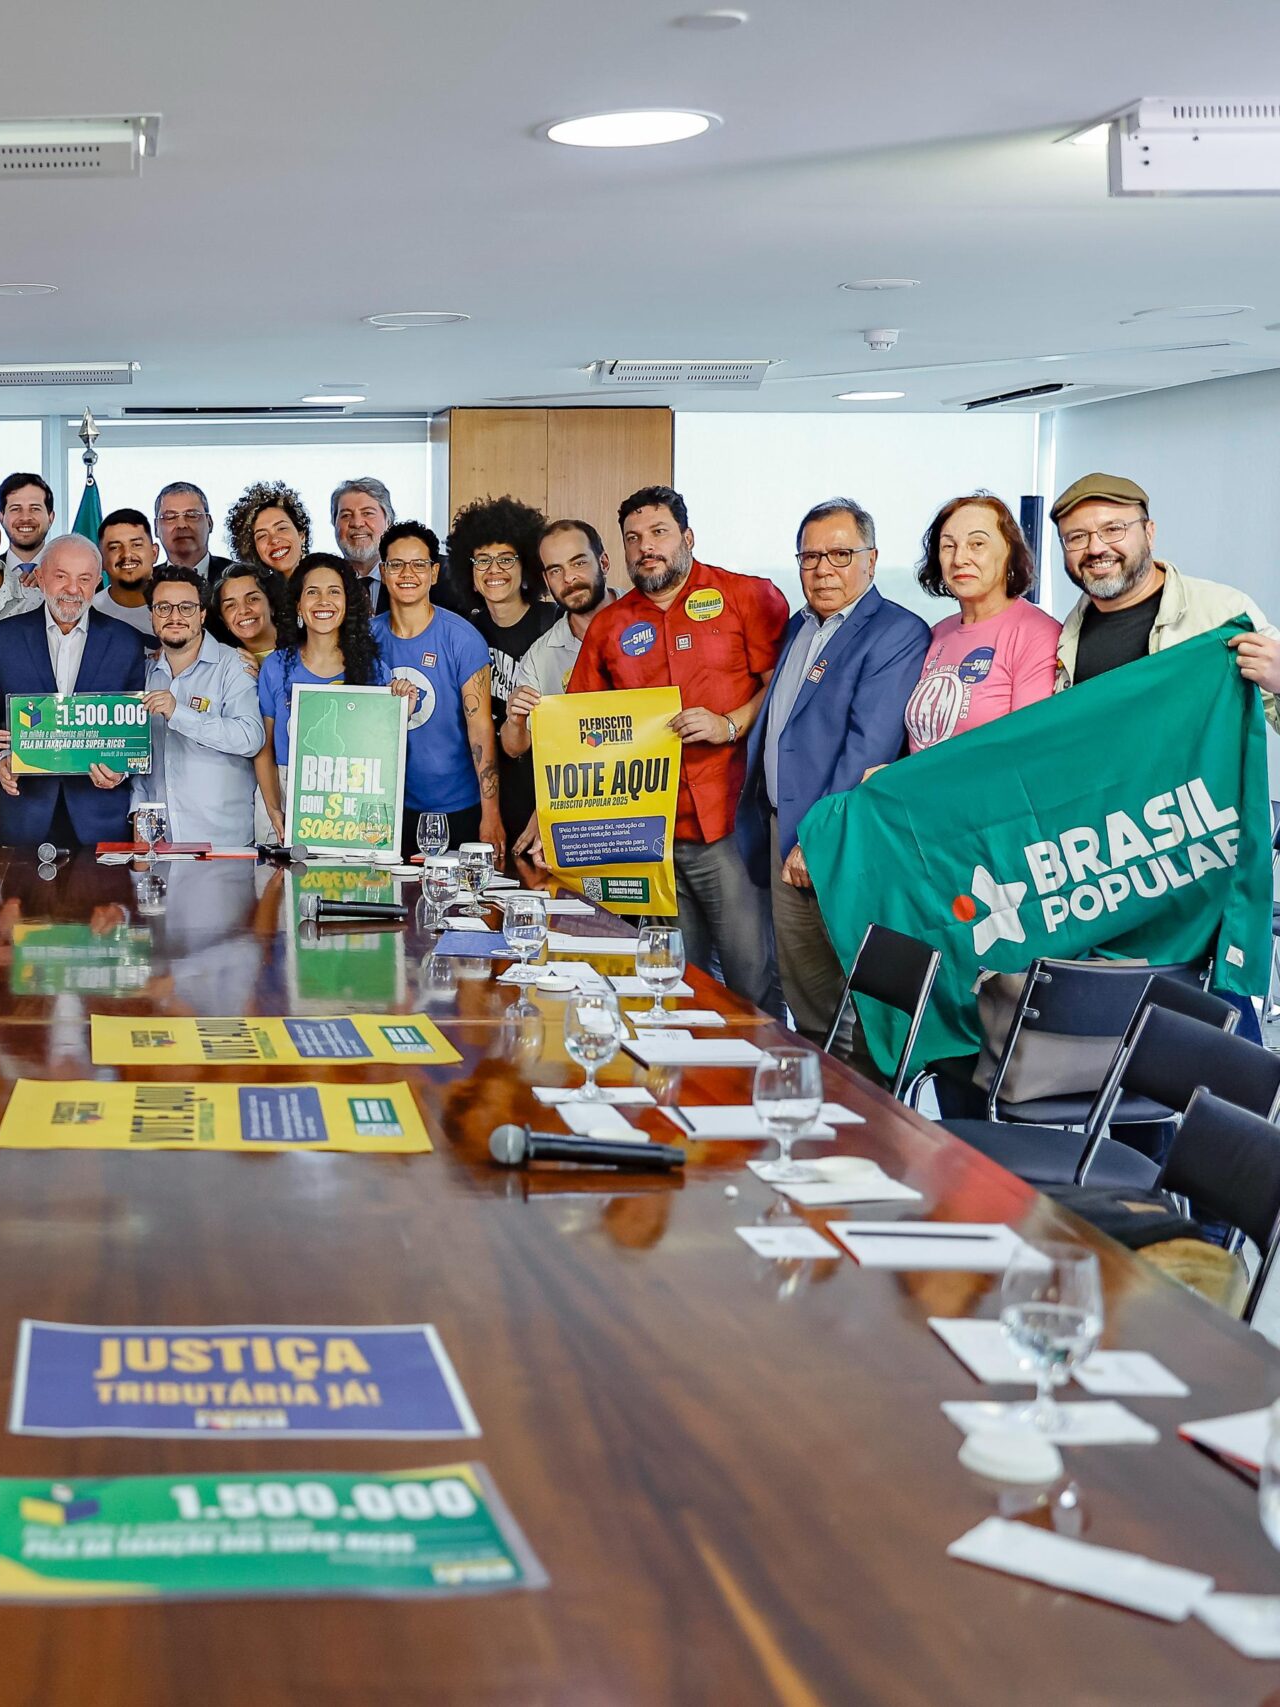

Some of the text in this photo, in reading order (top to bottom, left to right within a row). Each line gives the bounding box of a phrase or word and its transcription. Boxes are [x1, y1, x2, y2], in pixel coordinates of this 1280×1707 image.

[61, 703, 147, 726] 1.500.000
[579, 715, 632, 731] PLEBISCITO
[20, 739, 35, 749] PELA
[85, 739, 126, 749] SUPER-RICOS
[545, 757, 670, 800] VOTE AQUI
[325, 793, 343, 819] S
[550, 796, 628, 810] PLEBISCITO POPULAR 2025
[1024, 777, 1238, 895] BRASIL
[93, 1337, 372, 1380] JUSTIÇA
[94, 1379, 383, 1409] TRIBUTÁRIA JÁ!
[170, 1480, 478, 1520] 1.500.000
